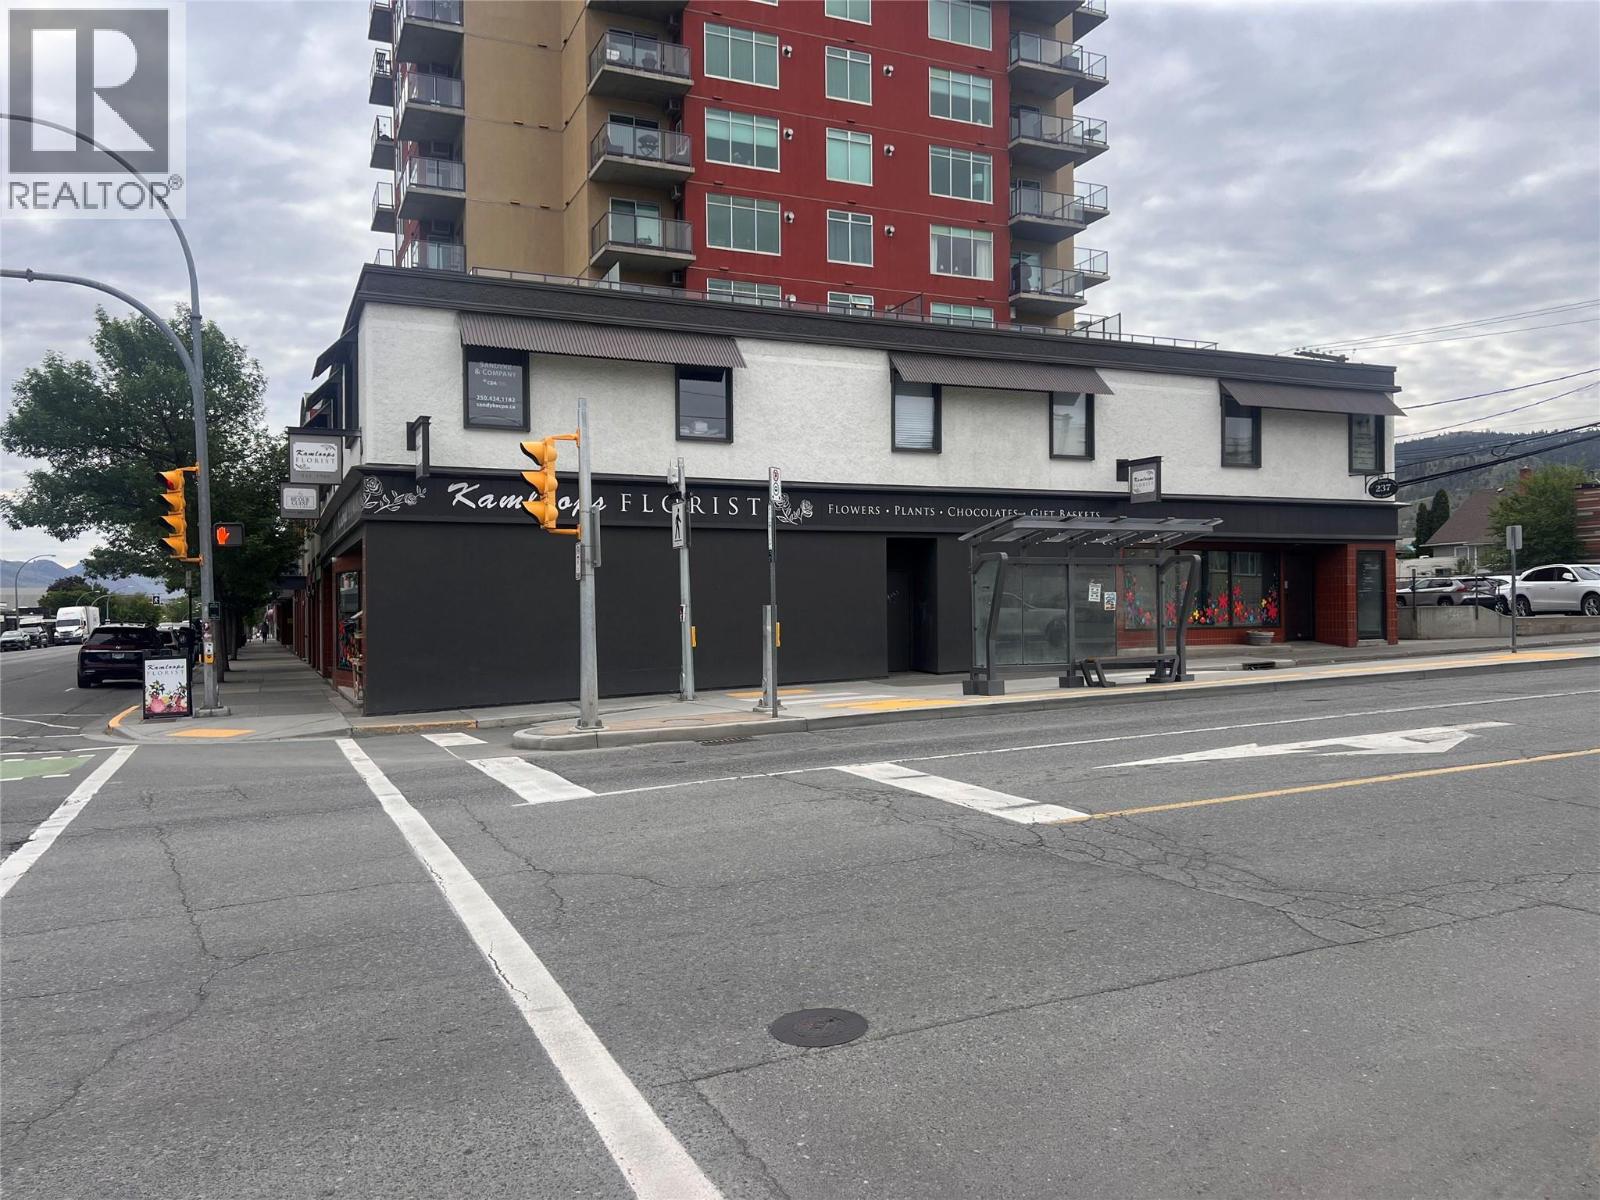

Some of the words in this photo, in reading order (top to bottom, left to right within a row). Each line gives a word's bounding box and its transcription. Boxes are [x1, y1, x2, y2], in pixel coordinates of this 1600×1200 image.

[482, 369, 516, 377] COMPANY
[296, 449, 335, 458] Kamloops
[1375, 484, 1391, 493] 237
[828, 504, 881, 515] FLOWERS
[894, 505, 935, 517] PLANTS
